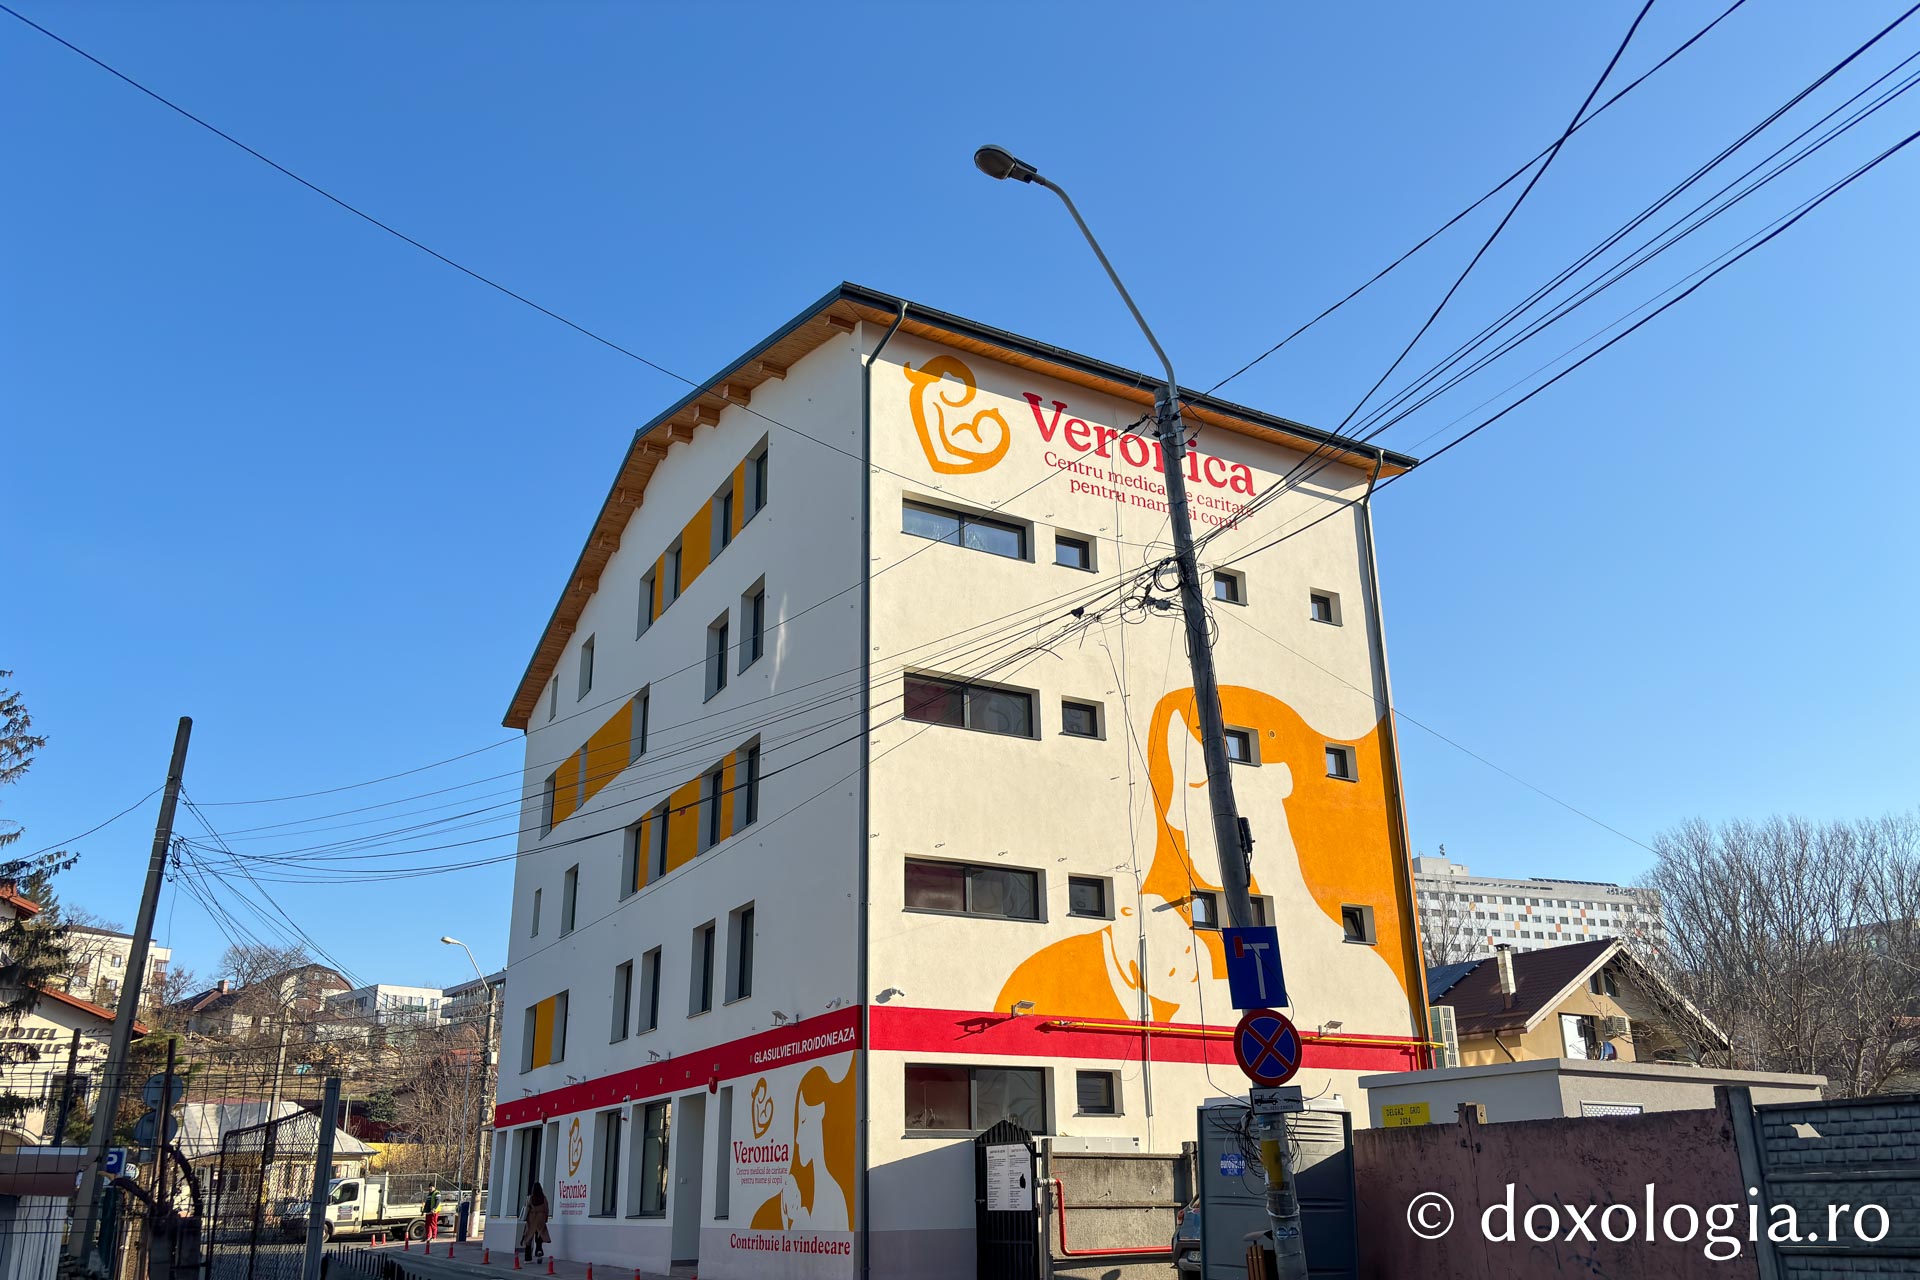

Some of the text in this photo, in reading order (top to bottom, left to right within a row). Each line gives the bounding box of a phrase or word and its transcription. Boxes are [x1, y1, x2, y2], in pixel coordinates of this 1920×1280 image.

[1044, 451, 1104, 480] Centru
[1108, 471, 1168, 496] medica
[1070, 478, 1127, 503] pentru
[1131, 494, 1171, 514] mam
[754, 1027, 855, 1064] GLASULVIETII.RO/DONEAZA
[733, 1138, 789, 1164] Veronica
[559, 1180, 587, 1199] Veronica
[730, 1233, 851, 1256] Contribuie la vindecare
